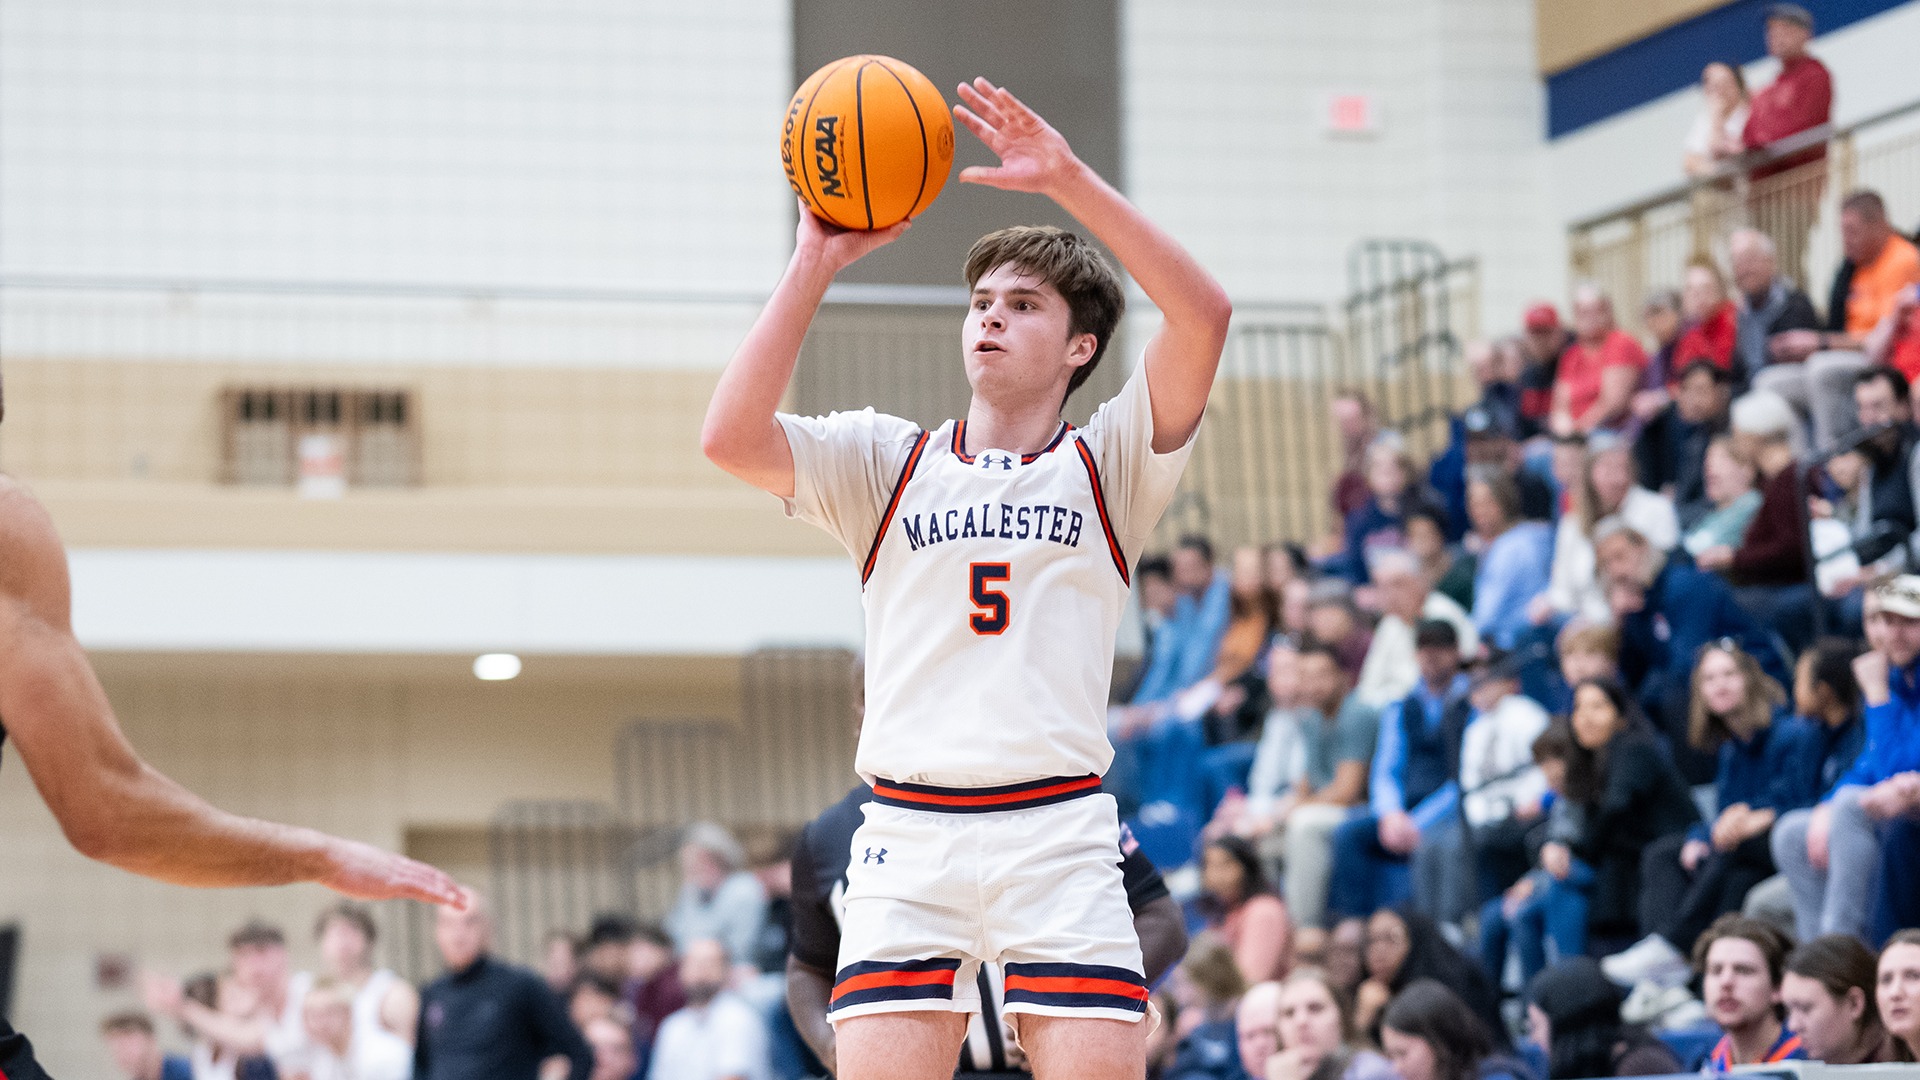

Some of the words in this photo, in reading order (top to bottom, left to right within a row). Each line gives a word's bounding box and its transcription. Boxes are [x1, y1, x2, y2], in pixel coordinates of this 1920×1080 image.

[815, 116, 846, 198] NCAA
[902, 503, 1084, 551] MACALESTER
[969, 562, 1011, 635] 5
